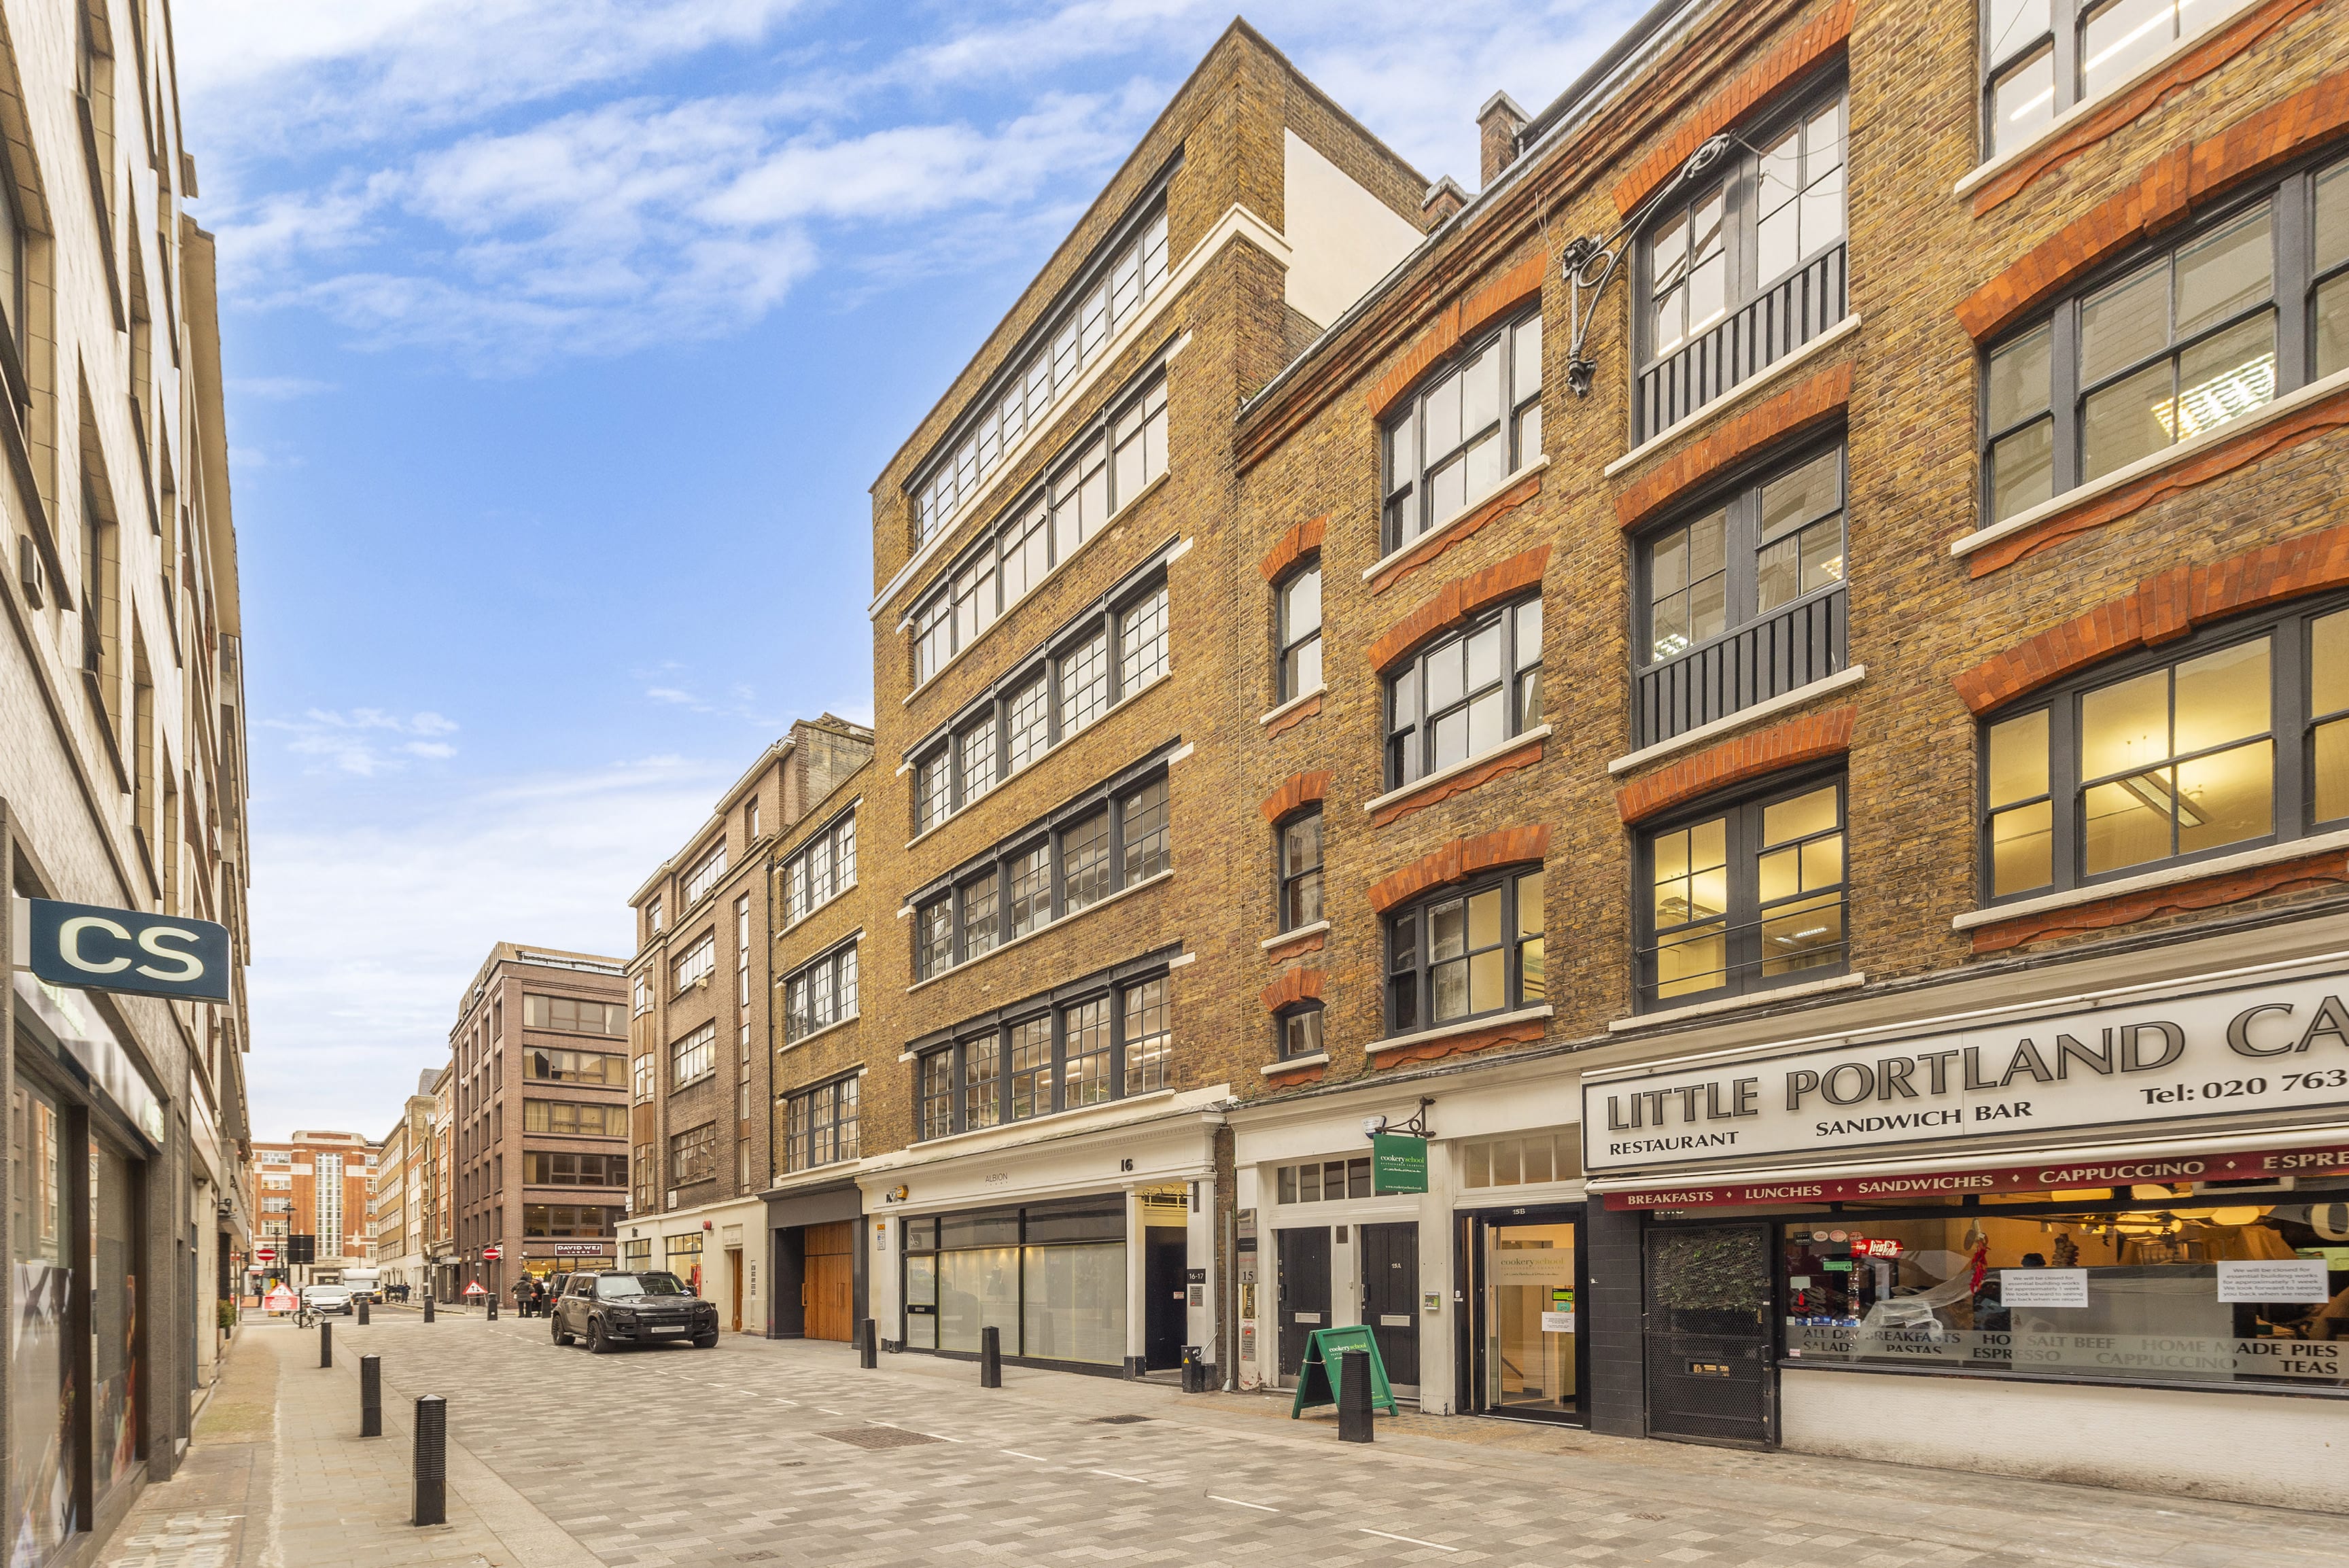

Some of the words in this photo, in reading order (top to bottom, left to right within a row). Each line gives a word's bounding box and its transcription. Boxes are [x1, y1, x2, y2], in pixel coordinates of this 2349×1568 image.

[58, 916, 205, 982] CS
[1607, 1077, 1758, 1130] LITTLE
[1786, 1021, 2186, 1111] PORTLAND
[2140, 1083, 2195, 1104] Tel:
[2202, 1077, 2267, 1099] 020
[2282, 1069, 2348, 1092] 763
[1816, 1109, 1962, 1136] SANDWICH
[1975, 1102, 2033, 1121] BAR
[1610, 1132, 1739, 1155] RESTAURANT
[986, 1172, 1008, 1183] ALBION
[1121, 1159, 1133, 1171] 16
[1628, 1191, 1713, 1204] BREAKFASTS
[1745, 1185, 1822, 1199] LUNCHES
[1858, 1175, 1994, 1194] SANDWICHES
[2038, 1161, 2206, 1183] CAPPUCCINO
[1243, 1271, 1253, 1280] 15
[1804, 1329, 1828, 1340] ALL
[1833, 1329, 1860, 1340] DAY
[1983, 1334, 2019, 1346] HOT
[2027, 1336, 2068, 1347] SALT
[2074, 1338, 2116, 1349] BEEF
[2141, 1338, 2206, 1353] HOME
[2214, 1341, 2283, 1355] MADE
[2291, 1344, 2339, 1358] PIES
[1887, 1344, 1943, 1355] PASTAS
[1973, 1348, 2061, 1362] ESPRESSO
[2095, 1352, 2238, 1370] CAPPUCCINO
[2279, 1359, 2339, 1374] TEAS
